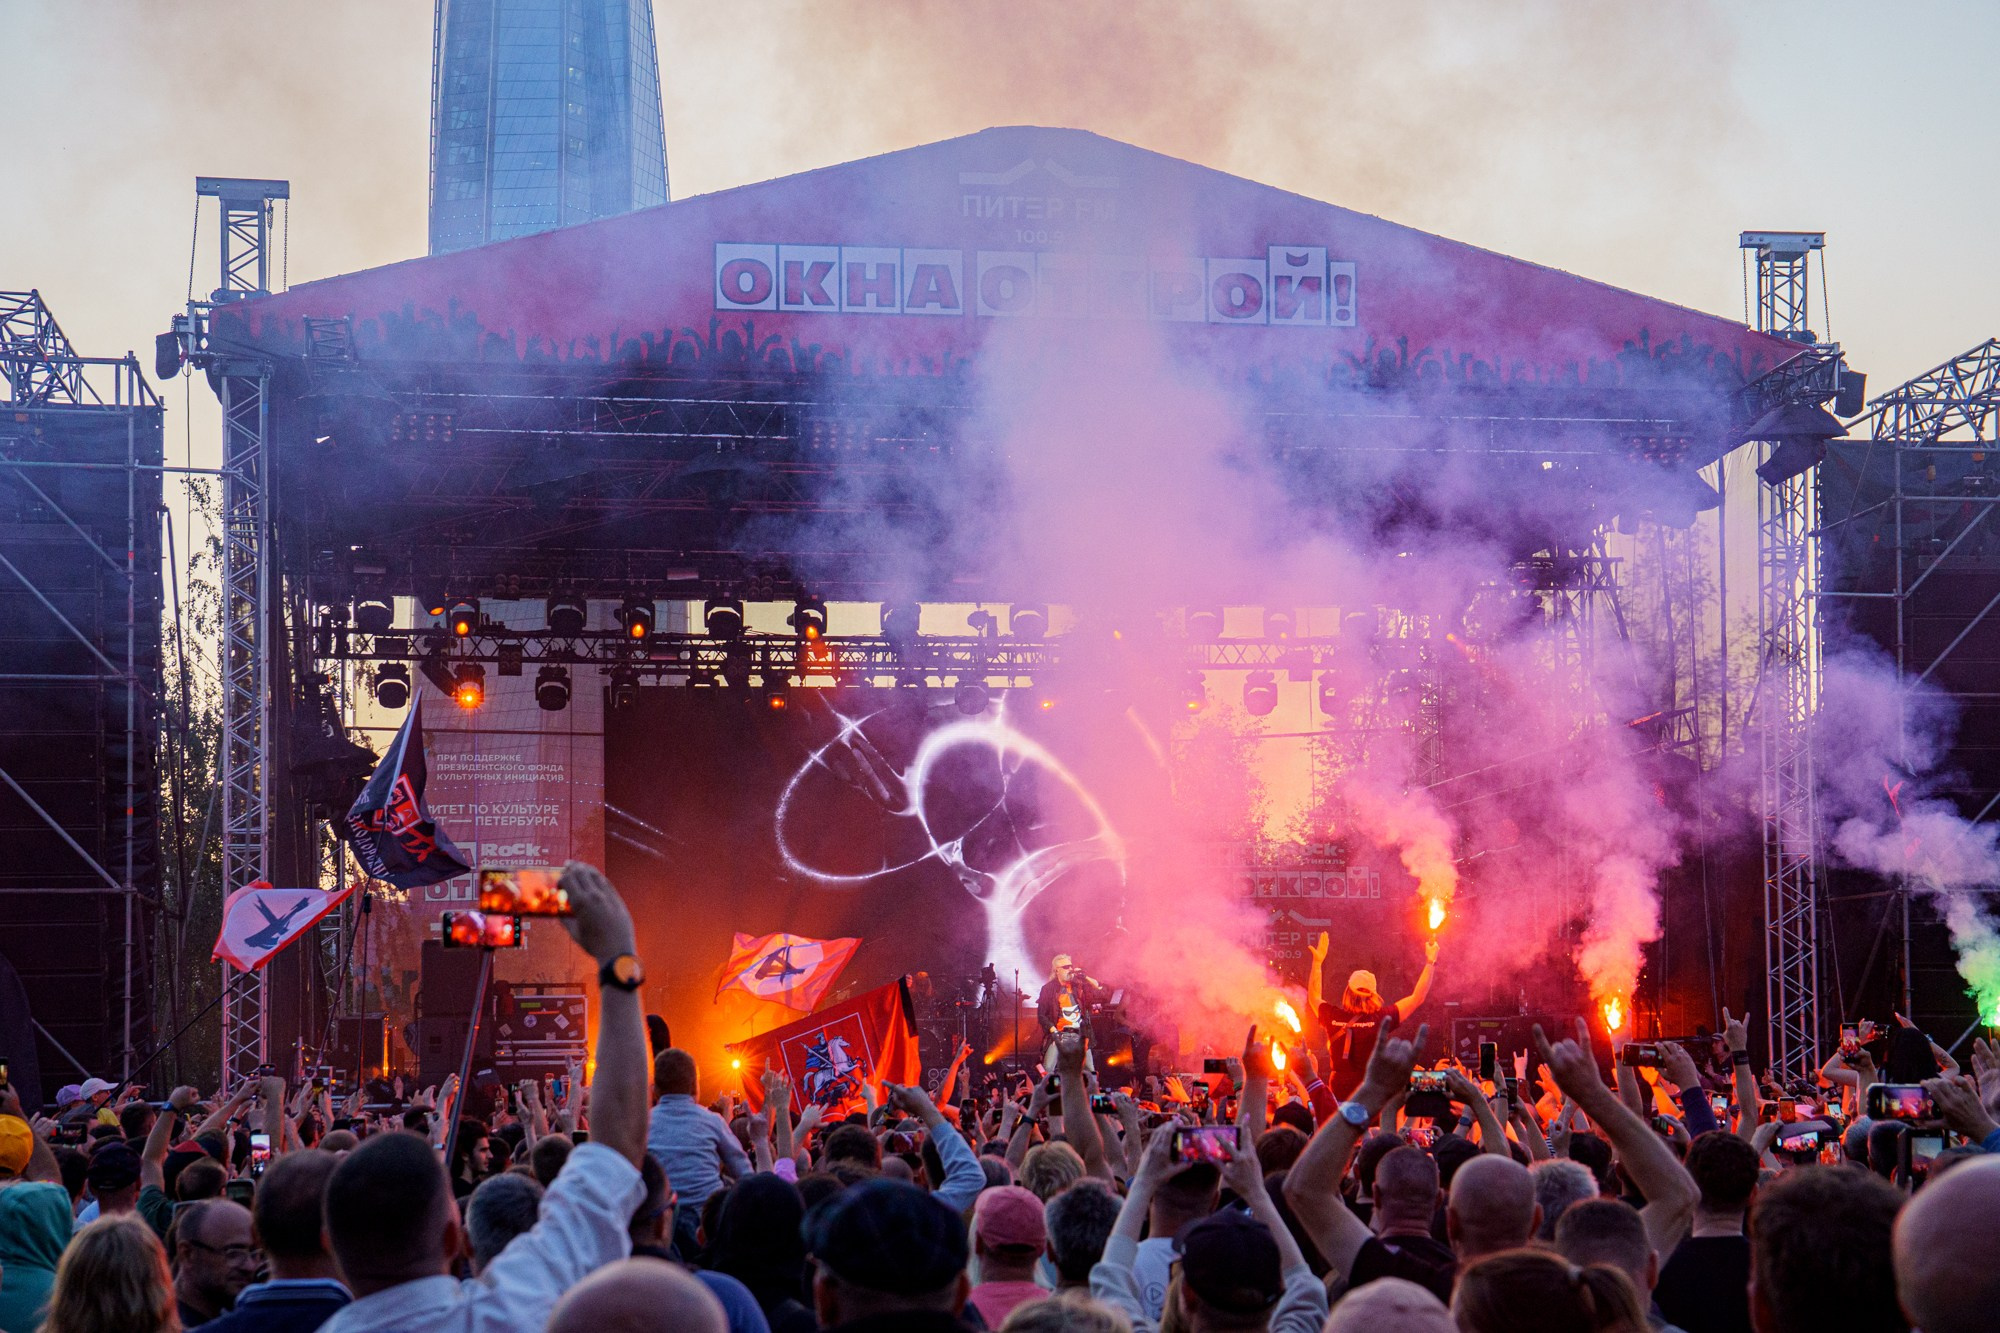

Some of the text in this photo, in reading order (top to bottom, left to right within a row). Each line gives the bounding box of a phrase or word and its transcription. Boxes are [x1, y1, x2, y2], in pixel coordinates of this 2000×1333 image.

[962, 195, 1065, 221] ПИТЕР
[718, 252, 1351, 322] ОКНА ОРОЙ!
[460, 754, 522, 762] ПОДДЕРЖКЕ
[436, 764, 564, 772] ПРЕЗИДЕНТСКОГО ФОНДА
[436, 773, 564, 782] КУЛЬТУРНЫХ ИНИЦИАТИВ
[469, 803, 489, 815] ПО
[492, 804, 560, 815] КУЛЬТУРЕ
[475, 816, 559, 826] ПЕТЕРБУРГА
[1238, 868, 1379, 898] ОТКРОЙ!
